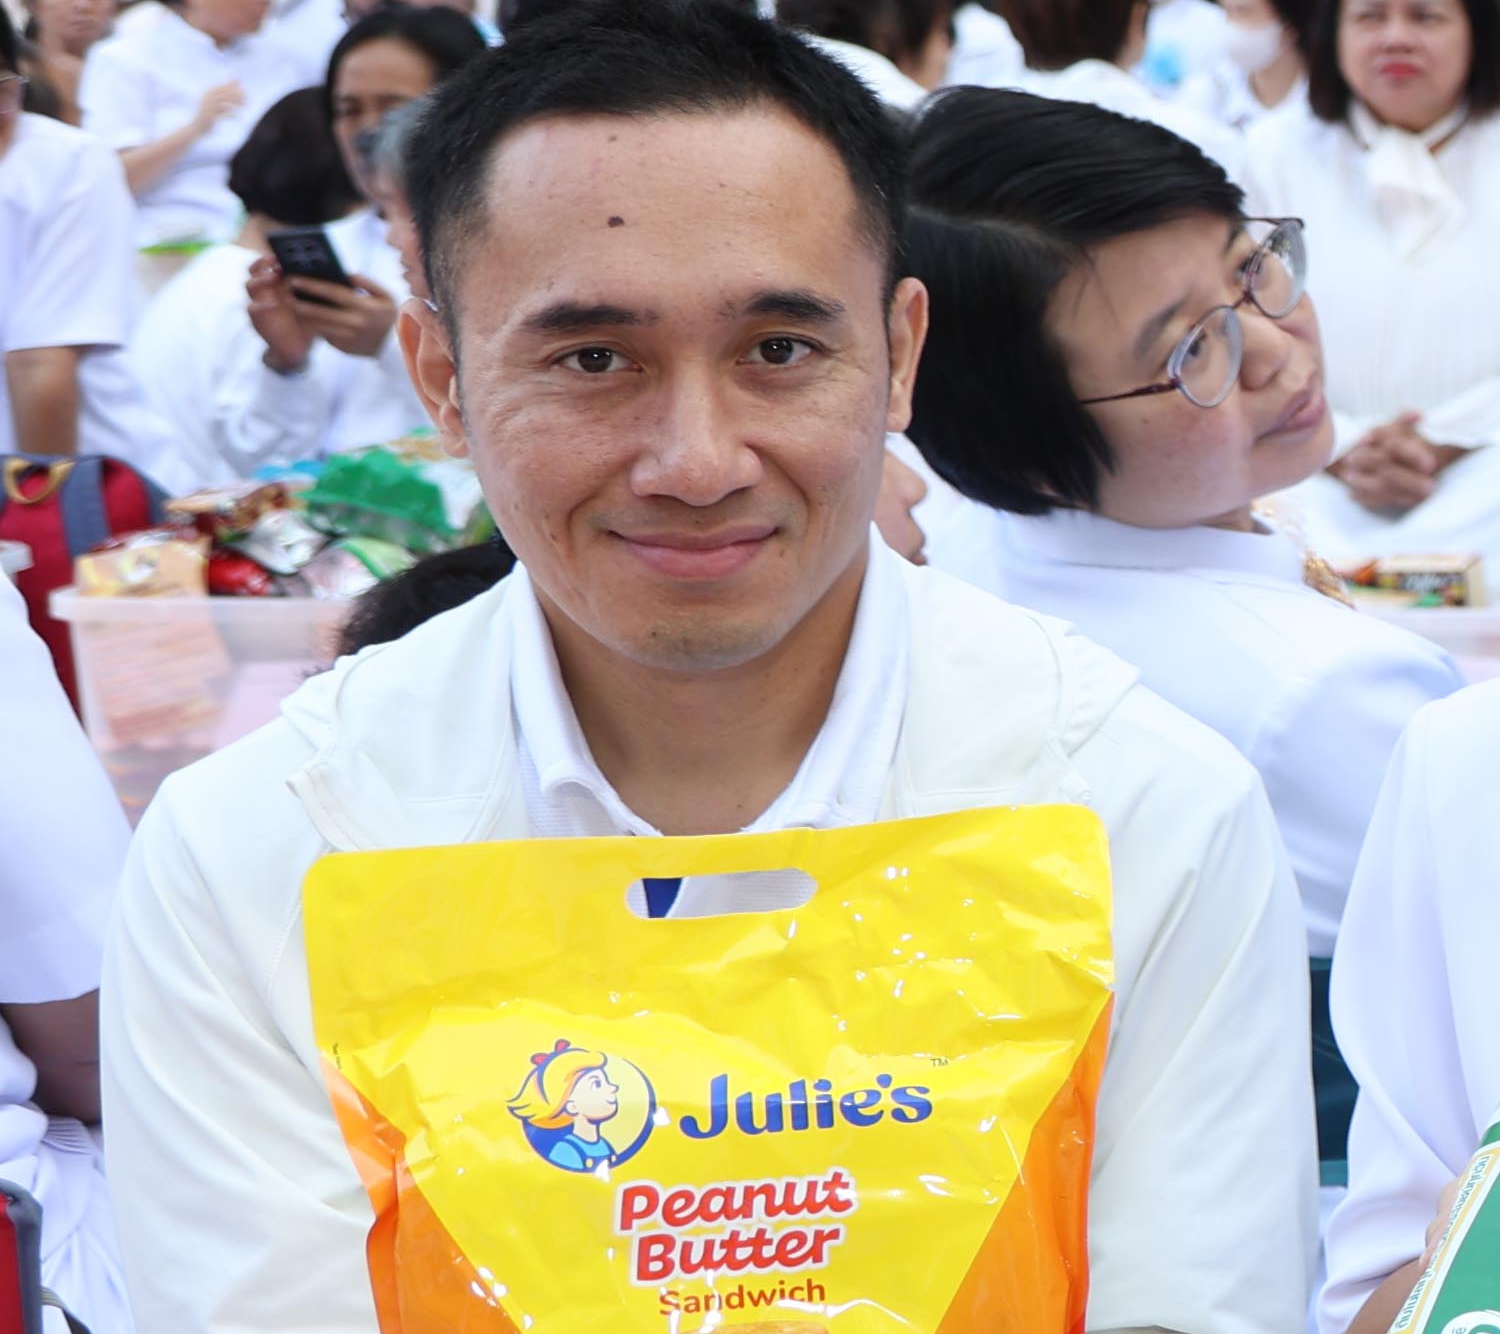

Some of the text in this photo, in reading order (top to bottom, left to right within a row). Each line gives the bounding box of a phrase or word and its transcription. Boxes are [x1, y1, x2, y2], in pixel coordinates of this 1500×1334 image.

[680, 1073, 933, 1139] Julie's
[620, 1171, 854, 1231] Peanut
[636, 1228, 840, 1281] Butter
[659, 1278, 826, 1316] Sandwich
